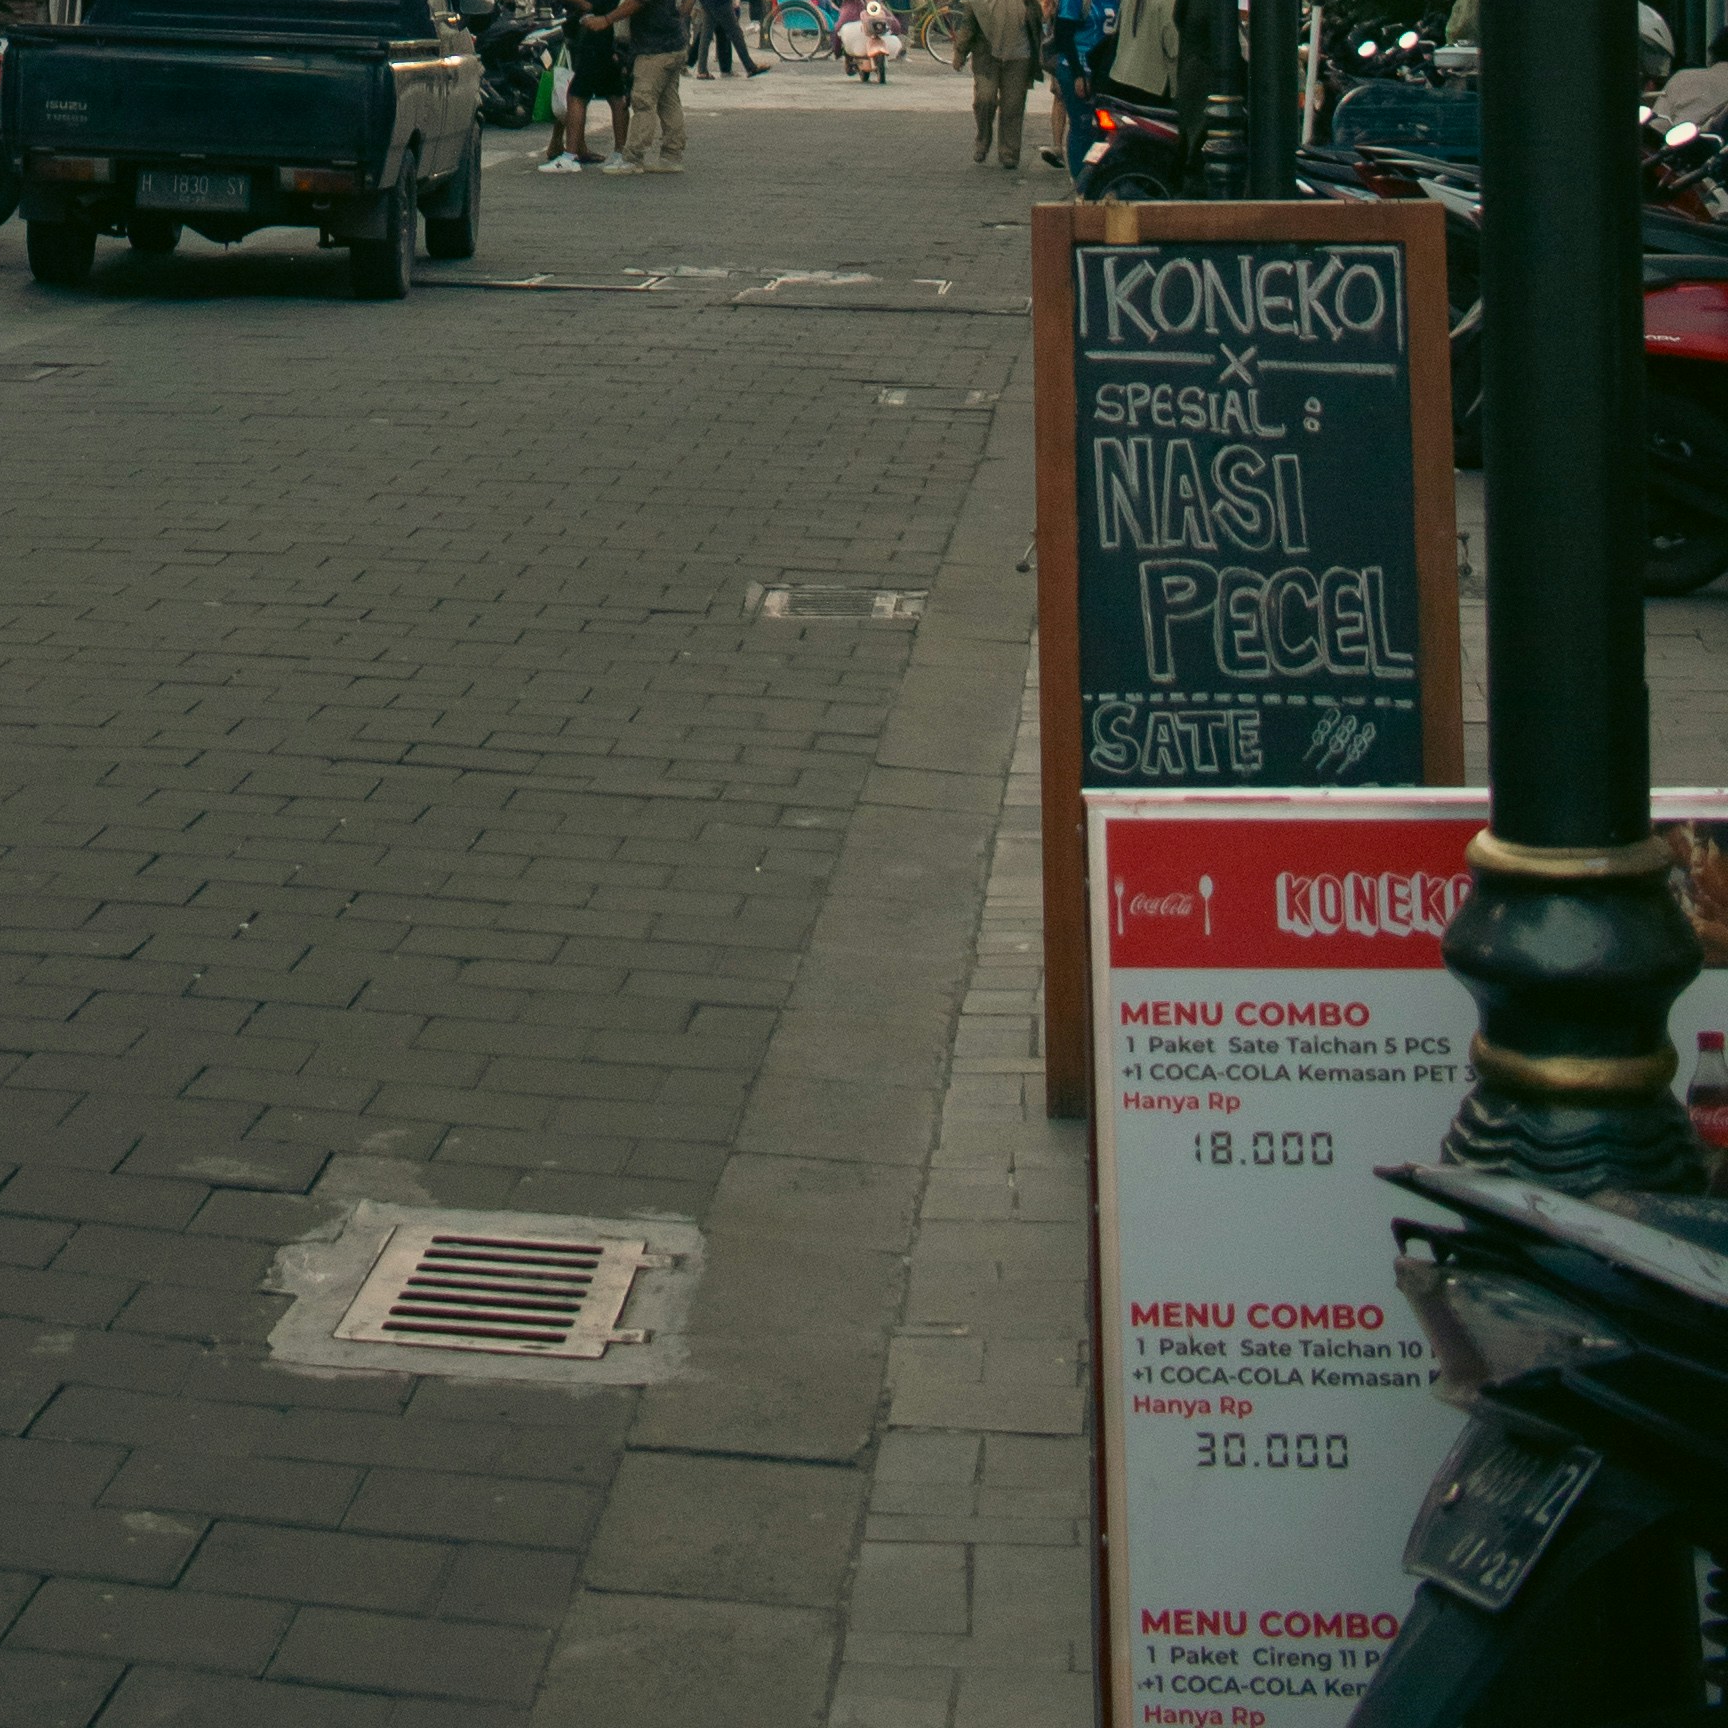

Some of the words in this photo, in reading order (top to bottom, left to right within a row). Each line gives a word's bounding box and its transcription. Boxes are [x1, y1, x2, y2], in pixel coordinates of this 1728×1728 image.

[45, 100, 88, 112] ISUZU
[142, 174, 152, 193] H
[173, 175, 209, 195] 1830
[1102, 253, 1385, 343] KONEKO
[1093, 382, 1286, 438] SPESIAL
[1093, 435, 1310, 555] NASI
[1139, 558, 1415, 684] PECEL
[1089, 700, 1263, 776] SATE
[1121, 1001, 1224, 1027] MENU
[1235, 1001, 1370, 1027] COMBO
[1127, 1036, 1136, 1054] 1
[1149, 1035, 1215, 1055] Paket
[1228, 1036, 1279, 1055] Sate
[1286, 1035, 1377, 1055] Taichan
[1385, 1037, 1398, 1055] 5
[1405, 1037, 1451, 1055] PCS
[1122, 1063, 1143, 1081] +1
[1150, 1063, 1291, 1082] COCA-COLA
[1298, 1064, 1406, 1082] Kemasan
[1414, 1064, 1458, 1082] PET
[1122, 1092, 1201, 1115] Hanya
[1208, 1093, 1241, 1115] Rp
[1194, 1130, 1334, 1165] 18.000
[1130, 1301, 1235, 1328] MENU
[1247, 1302, 1385, 1330] COMBO
[1136, 1338, 1145, 1356] 1
[1160, 1337, 1226, 1357] Paket
[1240, 1339, 1291, 1357] Sate
[1299, 1338, 1391, 1358] Taichan
[1400, 1341, 1422, 1359] 10
[1132, 1366, 1153, 1384] +1
[1160, 1366, 1304, 1386] COCA-COLA
[1311, 1368, 1421, 1387] Kemasan
[1133, 1395, 1211, 1419] Hanya
[1220, 1396, 1254, 1419] Rp
[1196, 1431, 1350, 1470] 30.000
[1141, 1609, 1248, 1637] MENU
[1259, 1610, 1400, 1640] COMBO
[1147, 1645, 1156, 1664] 1
[1171, 1645, 1239, 1666] Paket
[1253, 1647, 1332, 1672] Cireng
[1339, 1649, 1357, 1667] 11
[1142, 1675, 1164, 1693] +1
[1171, 1675, 1318, 1696] COCA-COLA
[1144, 1704, 1224, 1728] Hanya
[1232, 1706, 1266, 1728] Rp
